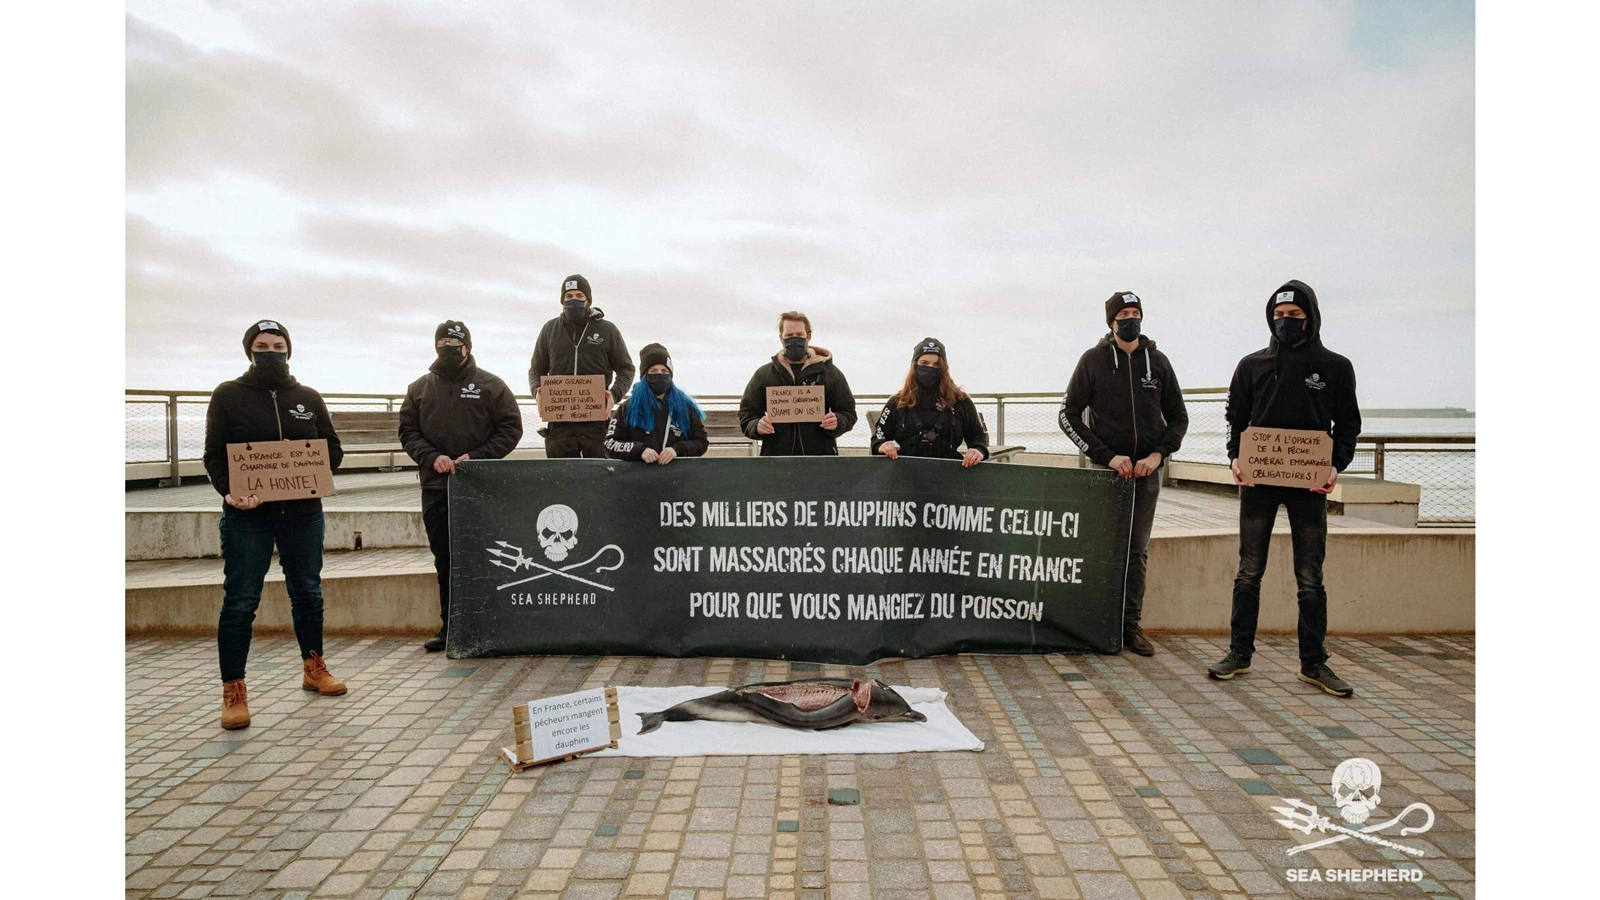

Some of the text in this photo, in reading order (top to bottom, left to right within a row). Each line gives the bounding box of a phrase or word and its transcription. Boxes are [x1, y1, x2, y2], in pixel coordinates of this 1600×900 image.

[771, 407, 791, 418] SHAME
[880, 408, 890, 425] SEA
[1252, 432, 1272, 442] STOP
[1257, 445, 1267, 453] DE
[233, 454, 244, 462] LA
[249, 452, 282, 461] FRANCE
[240, 462, 278, 472] CHARNIER
[247, 476, 264, 490] LA
[660, 501, 1080, 538] DES MILLIERS DE DAUPHINS COMME CELUI-CI
[653, 542, 1084, 584] SONT MASSACRÉS CHAQUE ANNÉE EN FRANCE
[511, 593, 597, 605] SEA SHEPHERD
[690, 592, 1043, 622] POUR QUE VOUS MANGIEZ DU POISSON
[532, 695, 602, 715] En France, certains
[534, 707, 604, 728] pêcheurs mangent
[552, 723, 590, 737] encore les
[555, 736, 590, 750] dauphins
